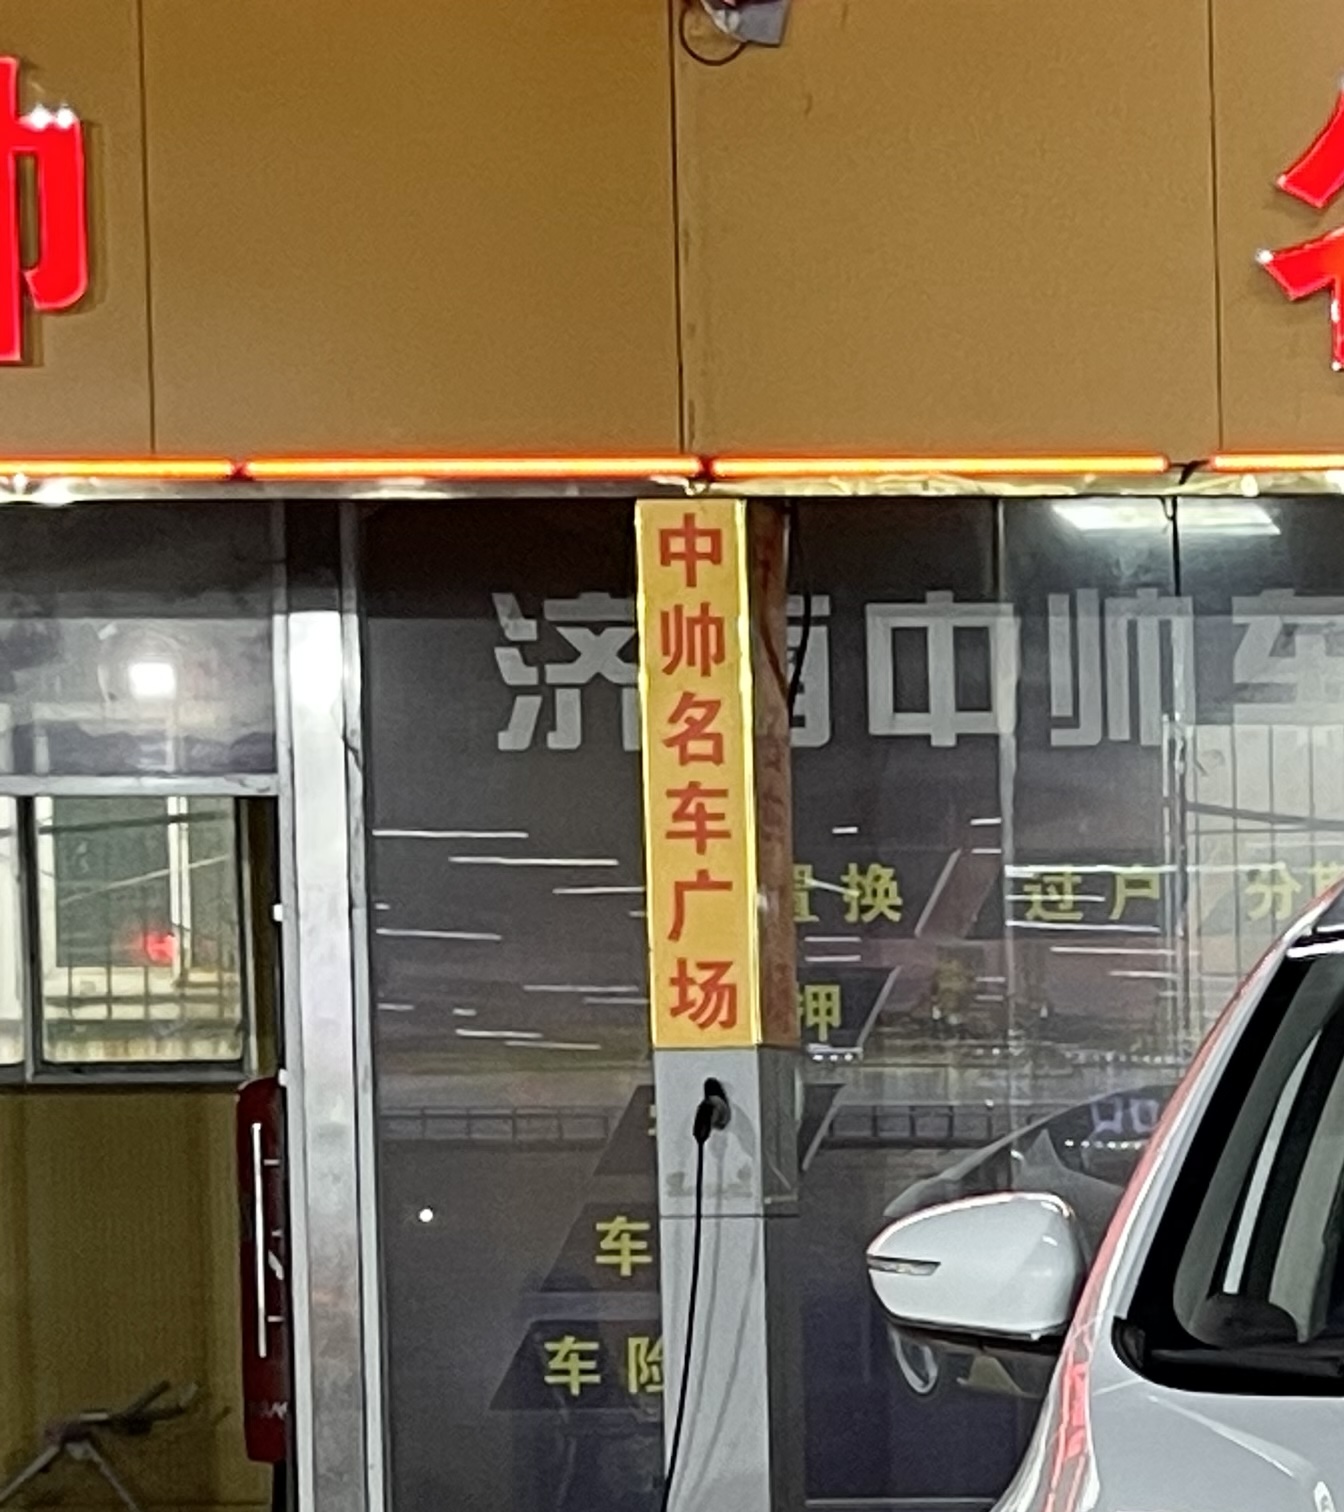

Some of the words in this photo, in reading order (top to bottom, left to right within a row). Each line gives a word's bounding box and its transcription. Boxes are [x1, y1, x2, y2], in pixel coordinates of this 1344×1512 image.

[658, 512, 738, 1030] 中帅名车广场
